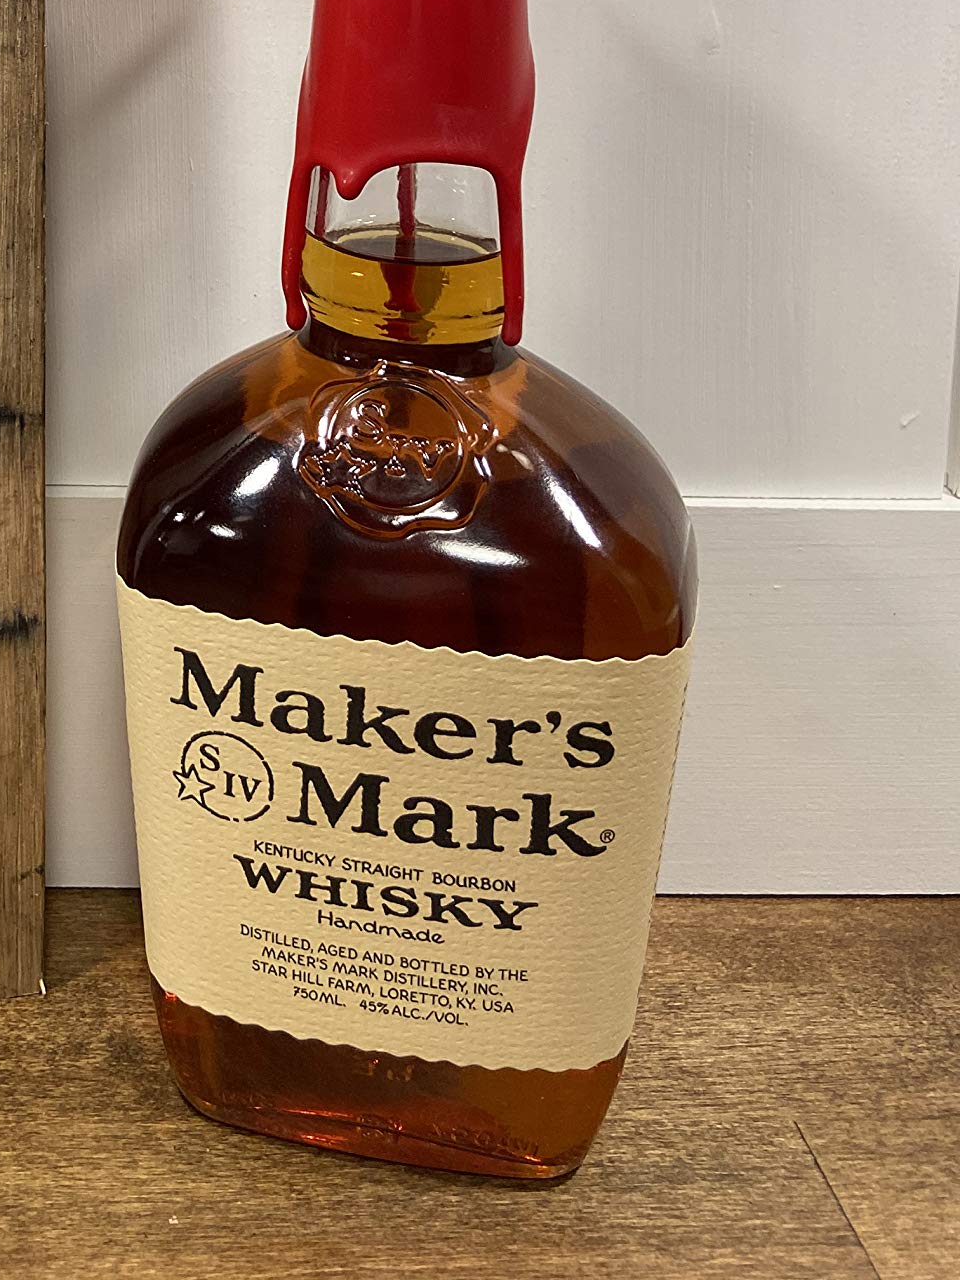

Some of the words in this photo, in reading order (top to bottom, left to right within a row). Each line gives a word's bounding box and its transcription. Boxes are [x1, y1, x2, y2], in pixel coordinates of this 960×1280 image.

[170, 646, 616, 769] Maker's
[199, 743, 221, 772] S
[222, 770, 263, 803] IV
[233, 853, 539, 931] WHISKY
[253, 839, 337, 868] KENTUCKY
[341, 857, 425, 882] STRAIGHT
[431, 871, 516, 893] BOURBON
[240, 923, 315, 955] DISTILLED,
[317, 942, 358, 960] AGED
[362, 950, 395, 966] AND
[399, 956, 470, 977] BOTTLED
[475, 966, 495, 980] BY
[498, 968, 529, 982] THE
[317, 909, 446, 945] Handmade
[251, 959, 288, 979] STAR
[292, 969, 324, 987] HILL
[328, 976, 375, 998] FARM,
[379, 986, 453, 1010] LORETTO,
[456, 996, 477, 1011] KY.
[482, 999, 514, 1014] USA
[261, 946, 328, 971] MAKER'S
[332, 961, 379, 980] MARK
[383, 969, 469, 996] DISTILLERY,
[473, 982, 504, 997] INC.
[293, 985, 347, 1008] 750ML.
